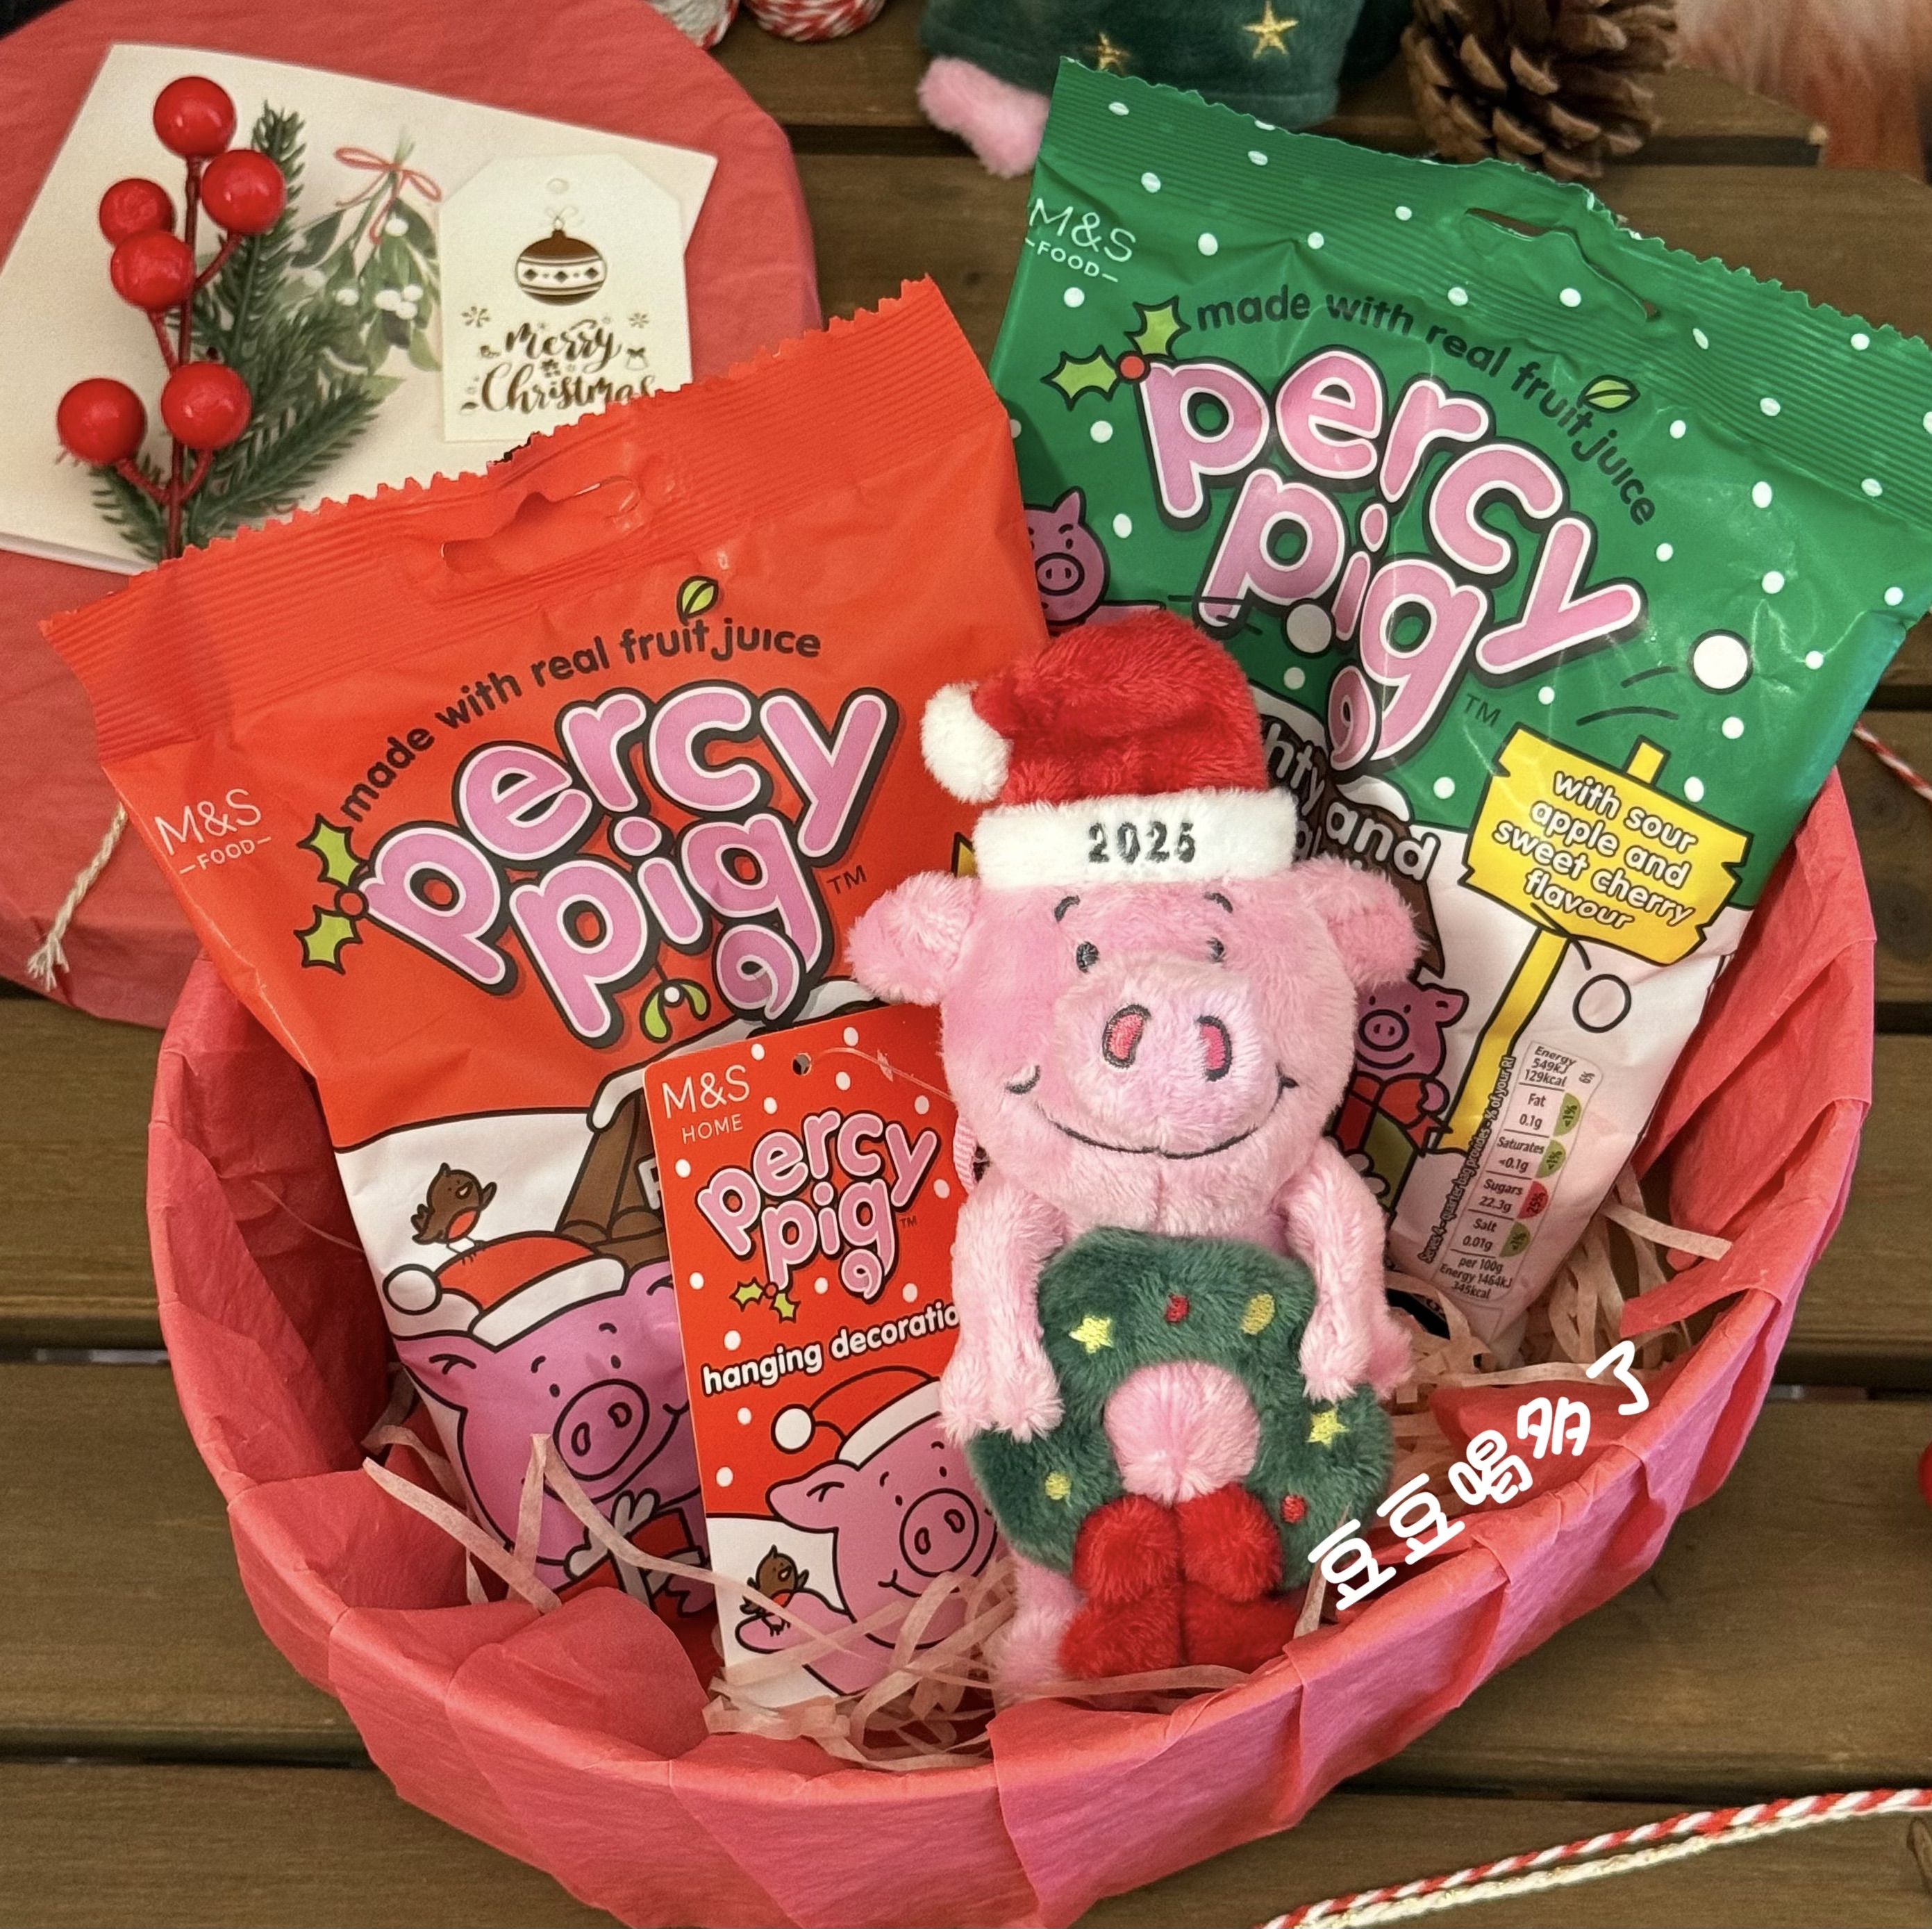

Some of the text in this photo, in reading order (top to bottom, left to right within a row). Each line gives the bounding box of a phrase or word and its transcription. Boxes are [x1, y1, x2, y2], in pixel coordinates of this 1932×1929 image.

[1029, 198, 1136, 262] M&S
[506, 318, 622, 374] Merry
[1197, 285, 1656, 526] made with real fruit juice
[1138, 349, 1642, 674] percy
[1197, 467, 1501, 771] pig TM
[340, 618, 822, 823] made with real fruit juice
[154, 788, 262, 856] M&S
[357, 684, 889, 986] percy
[1554, 770, 1699, 854] with sour
[1088, 820, 1197, 863] 2025
[1325, 801, 1438, 881] and
[1529, 800, 1692, 890] apple and
[1493, 820, 1696, 927] sweet cherry
[1523, 867, 1635, 929] flavour
[508, 811, 867, 1040] pig TM
[1525, 1068, 1568, 1088] 129kcal
[1531, 1057, 1569, 1075] 549kJ
[1534, 1045, 1577, 1068] Energy
[662, 1064, 750, 1119] M&S
[1527, 1093, 1547, 1108] Fat
[681, 1114, 744, 1145] HOME
[1496, 1136, 1545, 1155] Saturates
[1519, 1113, 1543, 1131] 0.1g
[697, 1110, 938, 1257] percy
[1483, 1178, 1524, 1197] Sugars
[1498, 1157, 1530, 1174] <0.1g
[1472, 1218, 1498, 1233] Salt
[1478, 1195, 1513, 1214] 22.3g
[760, 1178, 917, 1300] pig TM
[1458, 1257, 1504, 1275] per 100g
[1462, 1235, 1494, 1251] 0.01g
[1439, 1263, 1477, 1283] Energy
[702, 1302, 960, 1396] hanging decoratio
